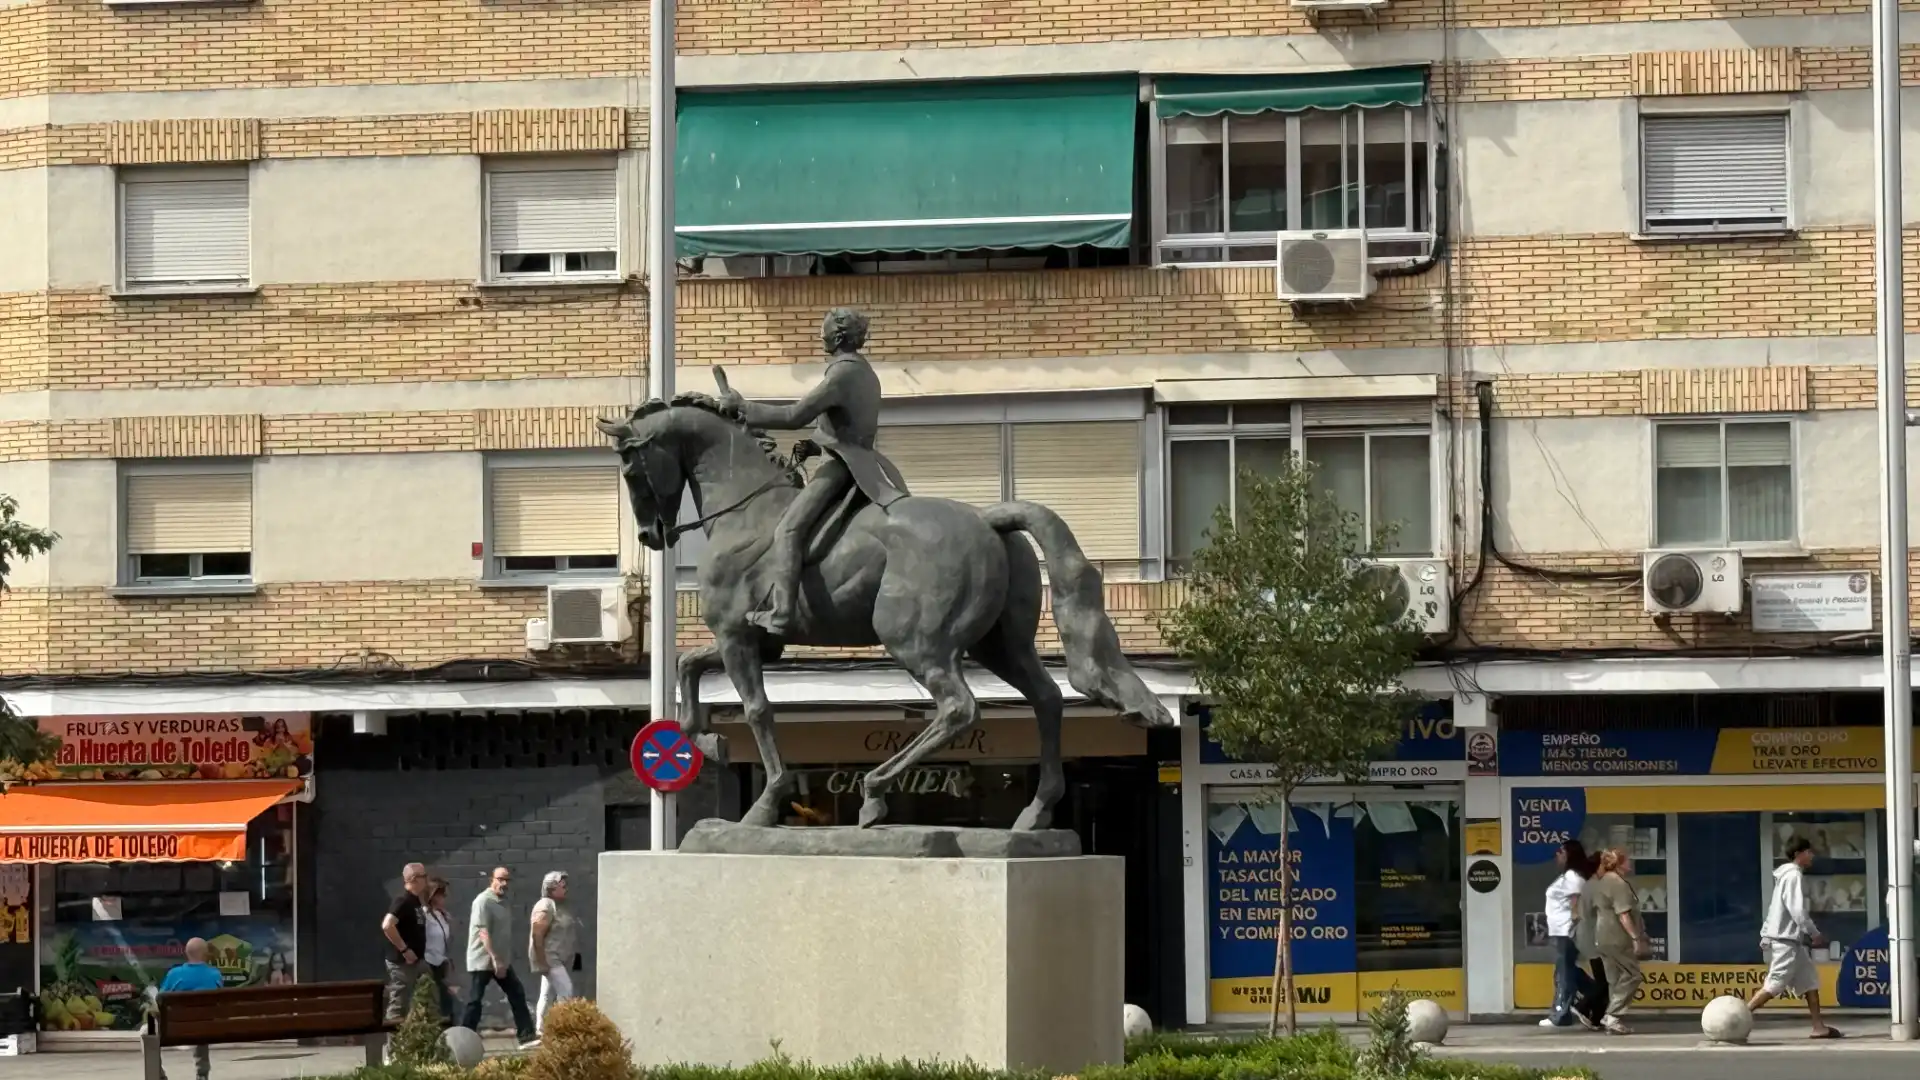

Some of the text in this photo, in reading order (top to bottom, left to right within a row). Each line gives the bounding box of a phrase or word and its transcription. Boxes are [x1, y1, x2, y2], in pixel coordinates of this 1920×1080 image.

[1419, 586, 1435, 596] LG
[66, 717, 240, 736] FRUTAS Y VERDURAS
[1542, 732, 1601, 746] EMPEÑO
[80, 739, 146, 764] Huerta
[150, 738, 177, 763] de
[180, 737, 250, 762] Toledo
[1580, 747, 1628, 758] TIEMPO
[1753, 745, 1821, 757] TRAE ORO
[1542, 760, 1589, 771] MENOS
[1813, 757, 1877, 769] EFECTIVO
[1230, 769, 1261, 779] CASA
[1411, 765, 1437, 776] ORO
[1518, 799, 1572, 813] VENTA
[1519, 815, 1541, 828] DE
[1519, 831, 1570, 844] JOYAS
[5, 835, 178, 858] LA HUERTA DE TOLEDO
[1218, 851, 1239, 864] LA
[1219, 888, 1250, 902] DEL
[1220, 908, 1242, 921] EN
[1219, 927, 1231, 940] Y
[1311, 926, 1348, 940] ORO
[1675, 971, 1696, 985] DE
[1855, 966, 1878, 979] DE
[1651, 988, 1686, 1001] ORO
